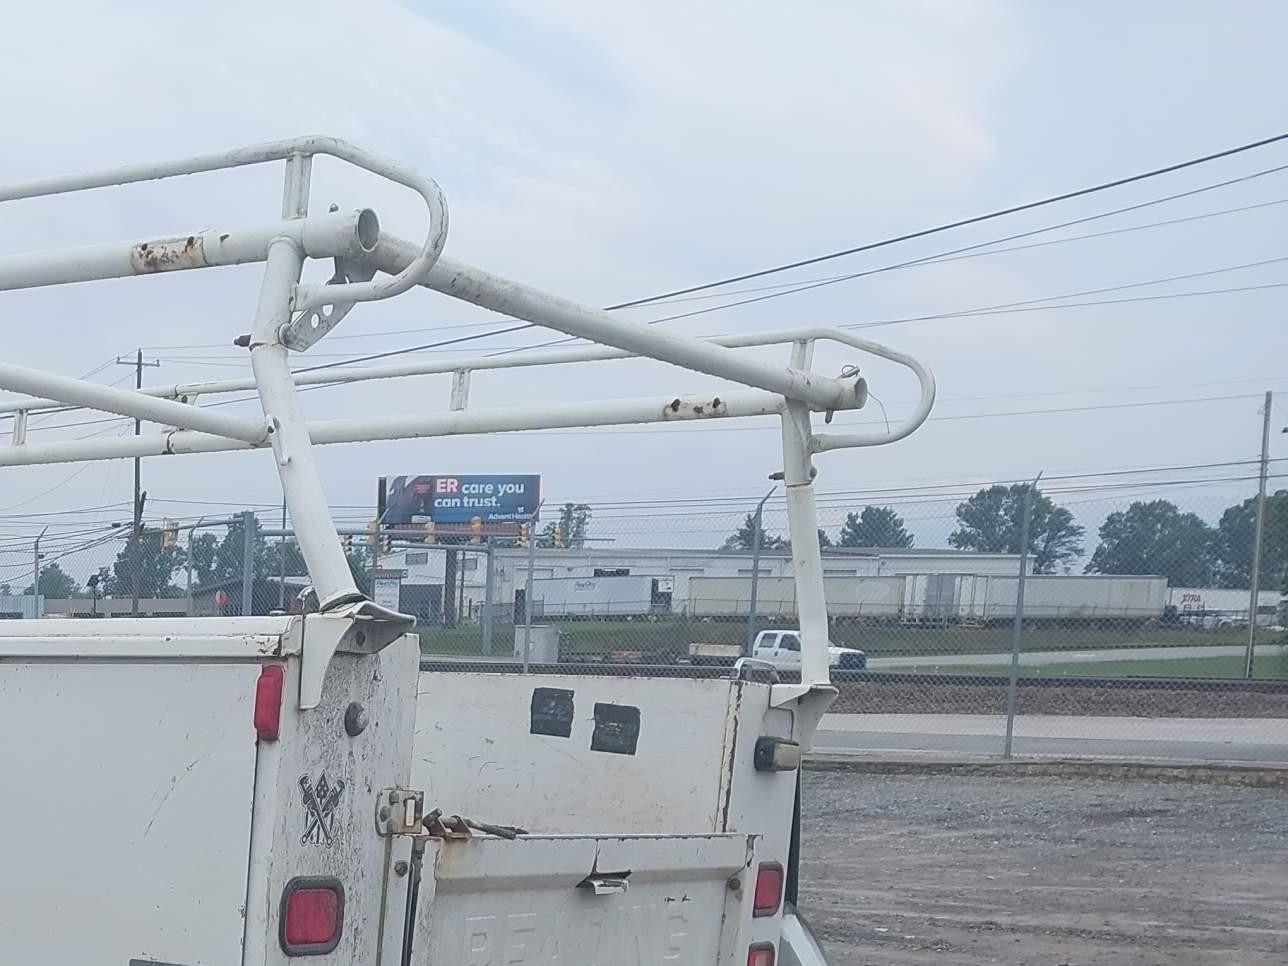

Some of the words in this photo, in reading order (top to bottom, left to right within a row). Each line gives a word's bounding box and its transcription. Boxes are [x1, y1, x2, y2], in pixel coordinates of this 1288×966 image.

[436, 478, 458, 493] ER
[461, 483, 494, 494] care
[498, 482, 524, 496] you
[434, 498, 461, 508] can
[462, 496, 501, 508] trust.
